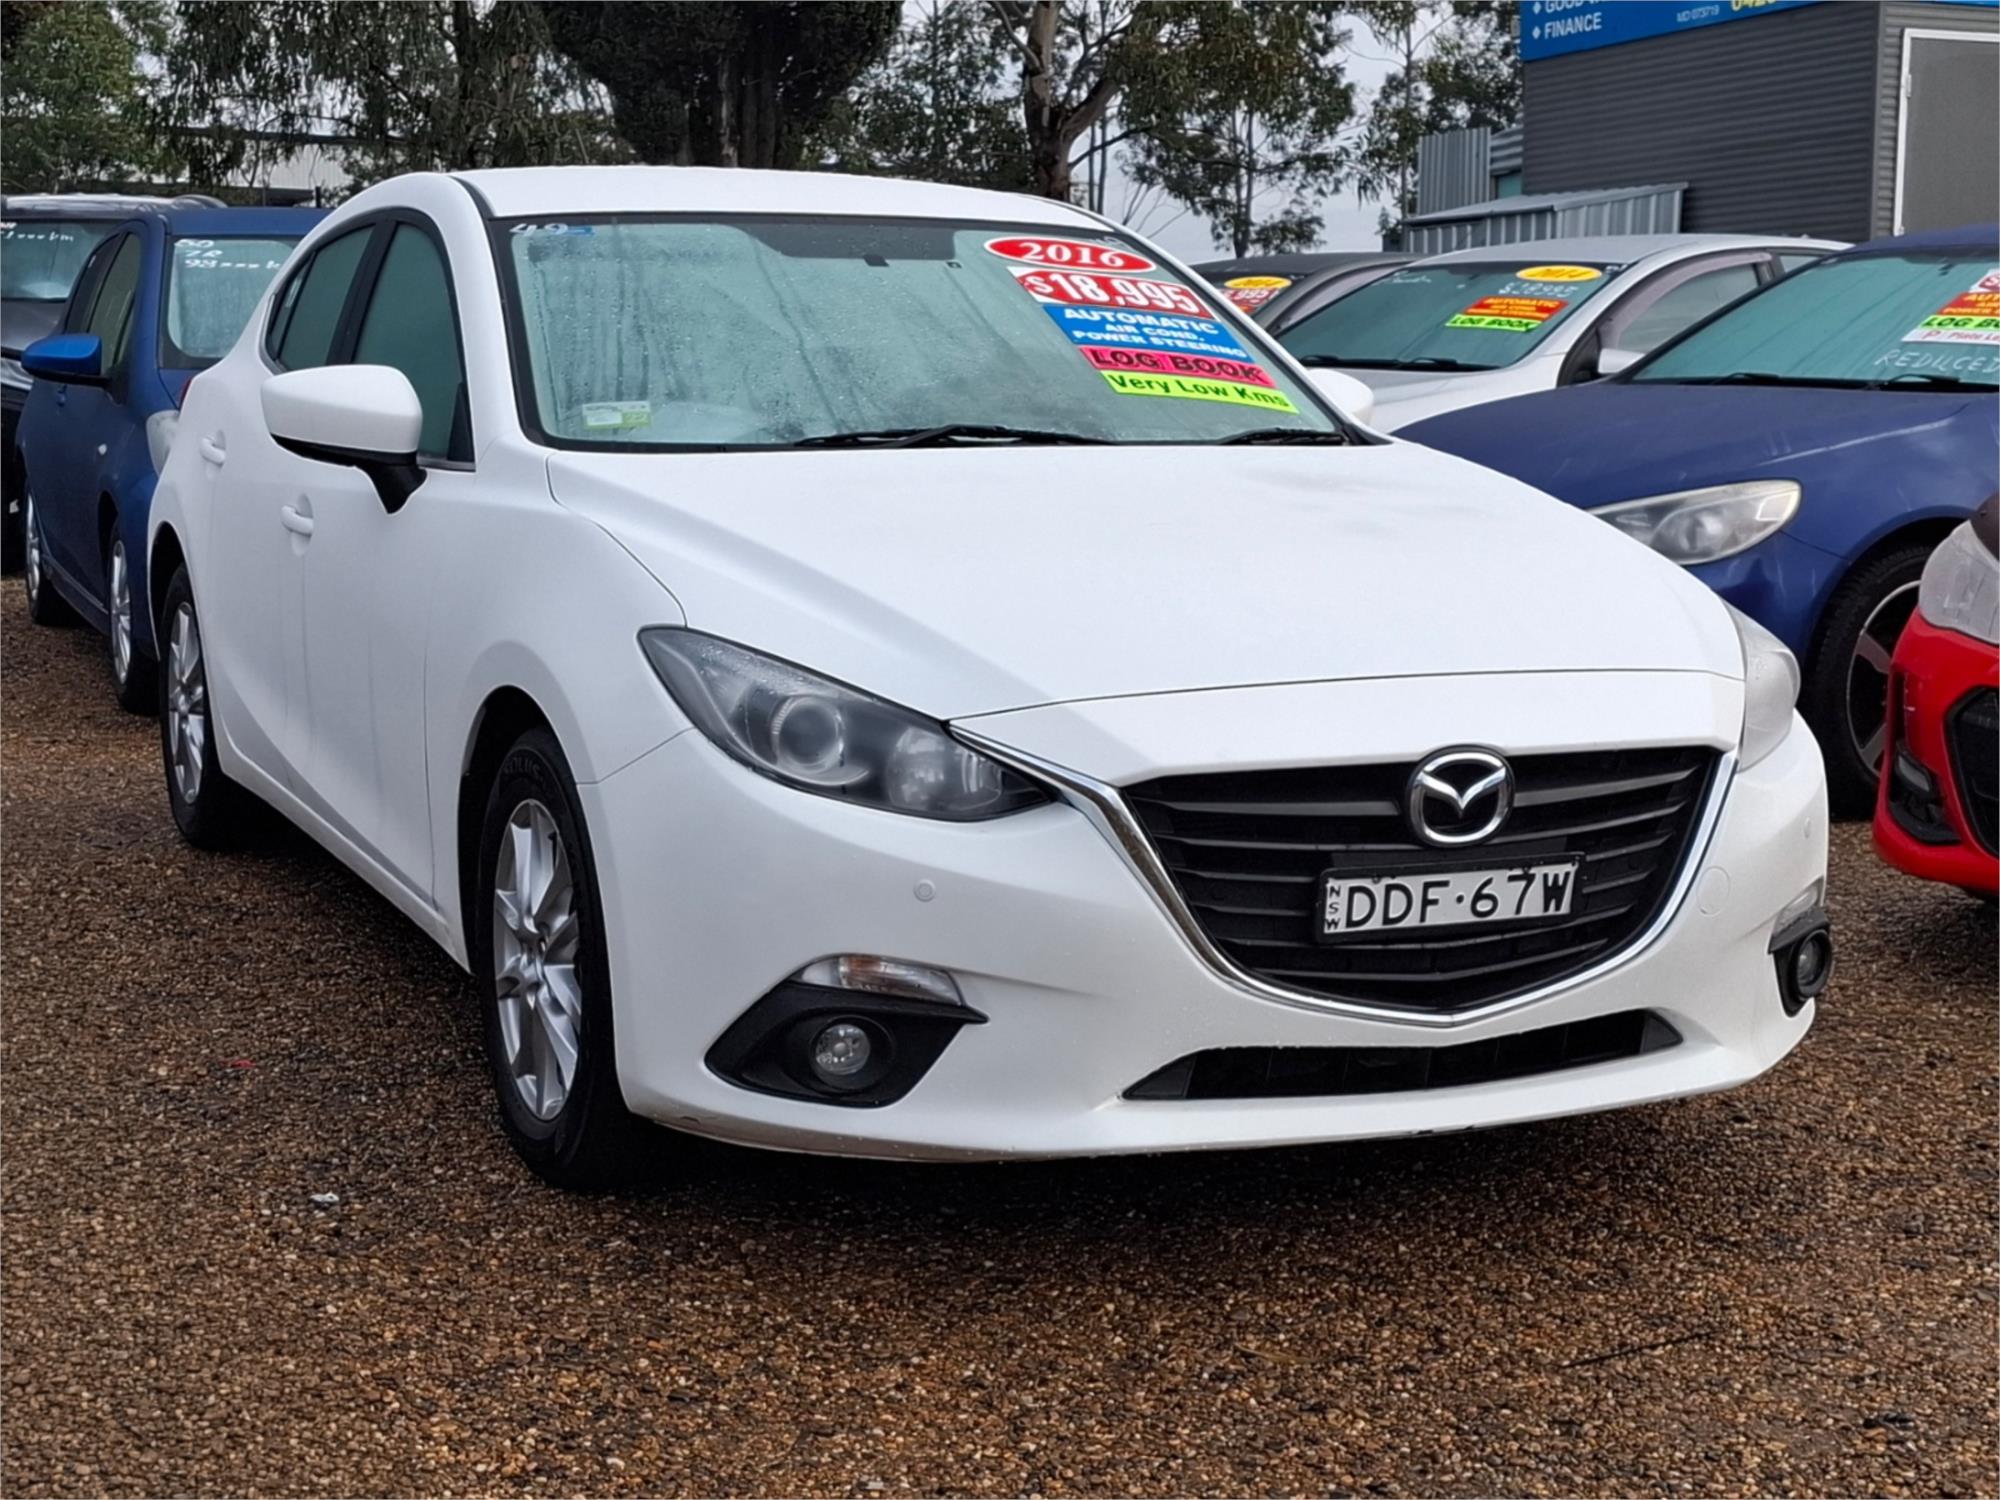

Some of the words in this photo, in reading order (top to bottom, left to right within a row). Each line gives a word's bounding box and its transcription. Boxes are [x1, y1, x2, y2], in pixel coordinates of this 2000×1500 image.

[1545, 12, 1603, 39] FINANCE
[1018, 242, 1126, 268] 2016
[1024, 273, 1200, 313] $18,995
[1063, 308, 1219, 335] AUTOMATIC
[1105, 323, 1141, 334] AIR
[1141, 326, 1205, 342] COND.
[1486, 318, 1530, 330] BOOK
[1921, 317, 1974, 327] LOG
[1071, 330, 1148, 345] POWER
[1149, 336, 1248, 358] STEERING
[1089, 349, 1158, 368] LOG
[1168, 354, 1270, 386] BOOK
[1108, 374, 1171, 394] Very
[1175, 379, 1229, 397] Low
[1234, 386, 1290, 407] Kms
[1326, 885, 1342, 931] NSW
